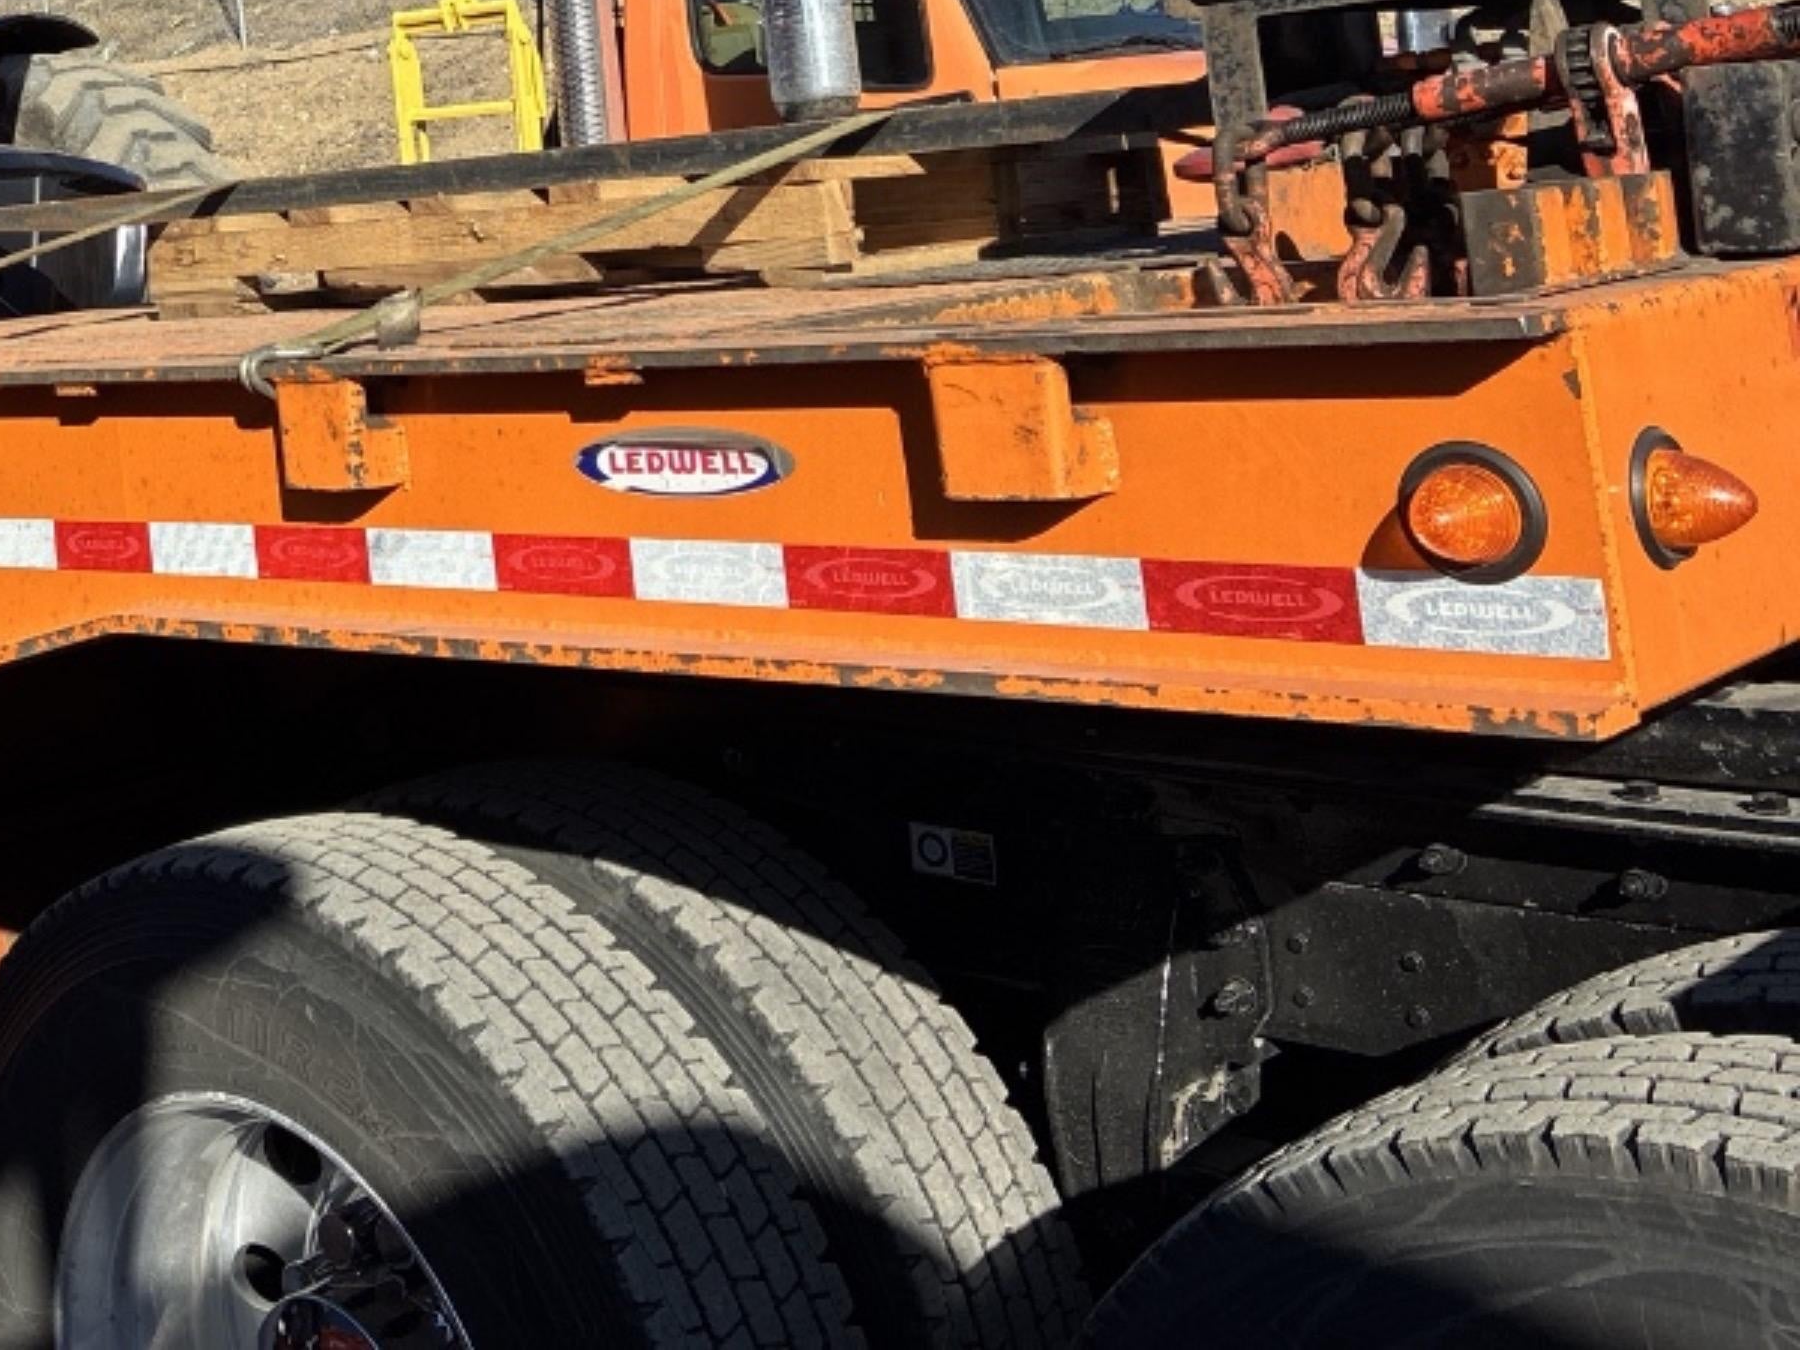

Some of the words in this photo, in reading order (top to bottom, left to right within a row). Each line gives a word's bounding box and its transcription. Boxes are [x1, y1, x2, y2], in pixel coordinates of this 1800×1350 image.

[608, 450, 757, 475] LEDWELL
[1208, 589, 1308, 608] LEDWELL
[1424, 600, 1536, 621] LEDWELL
